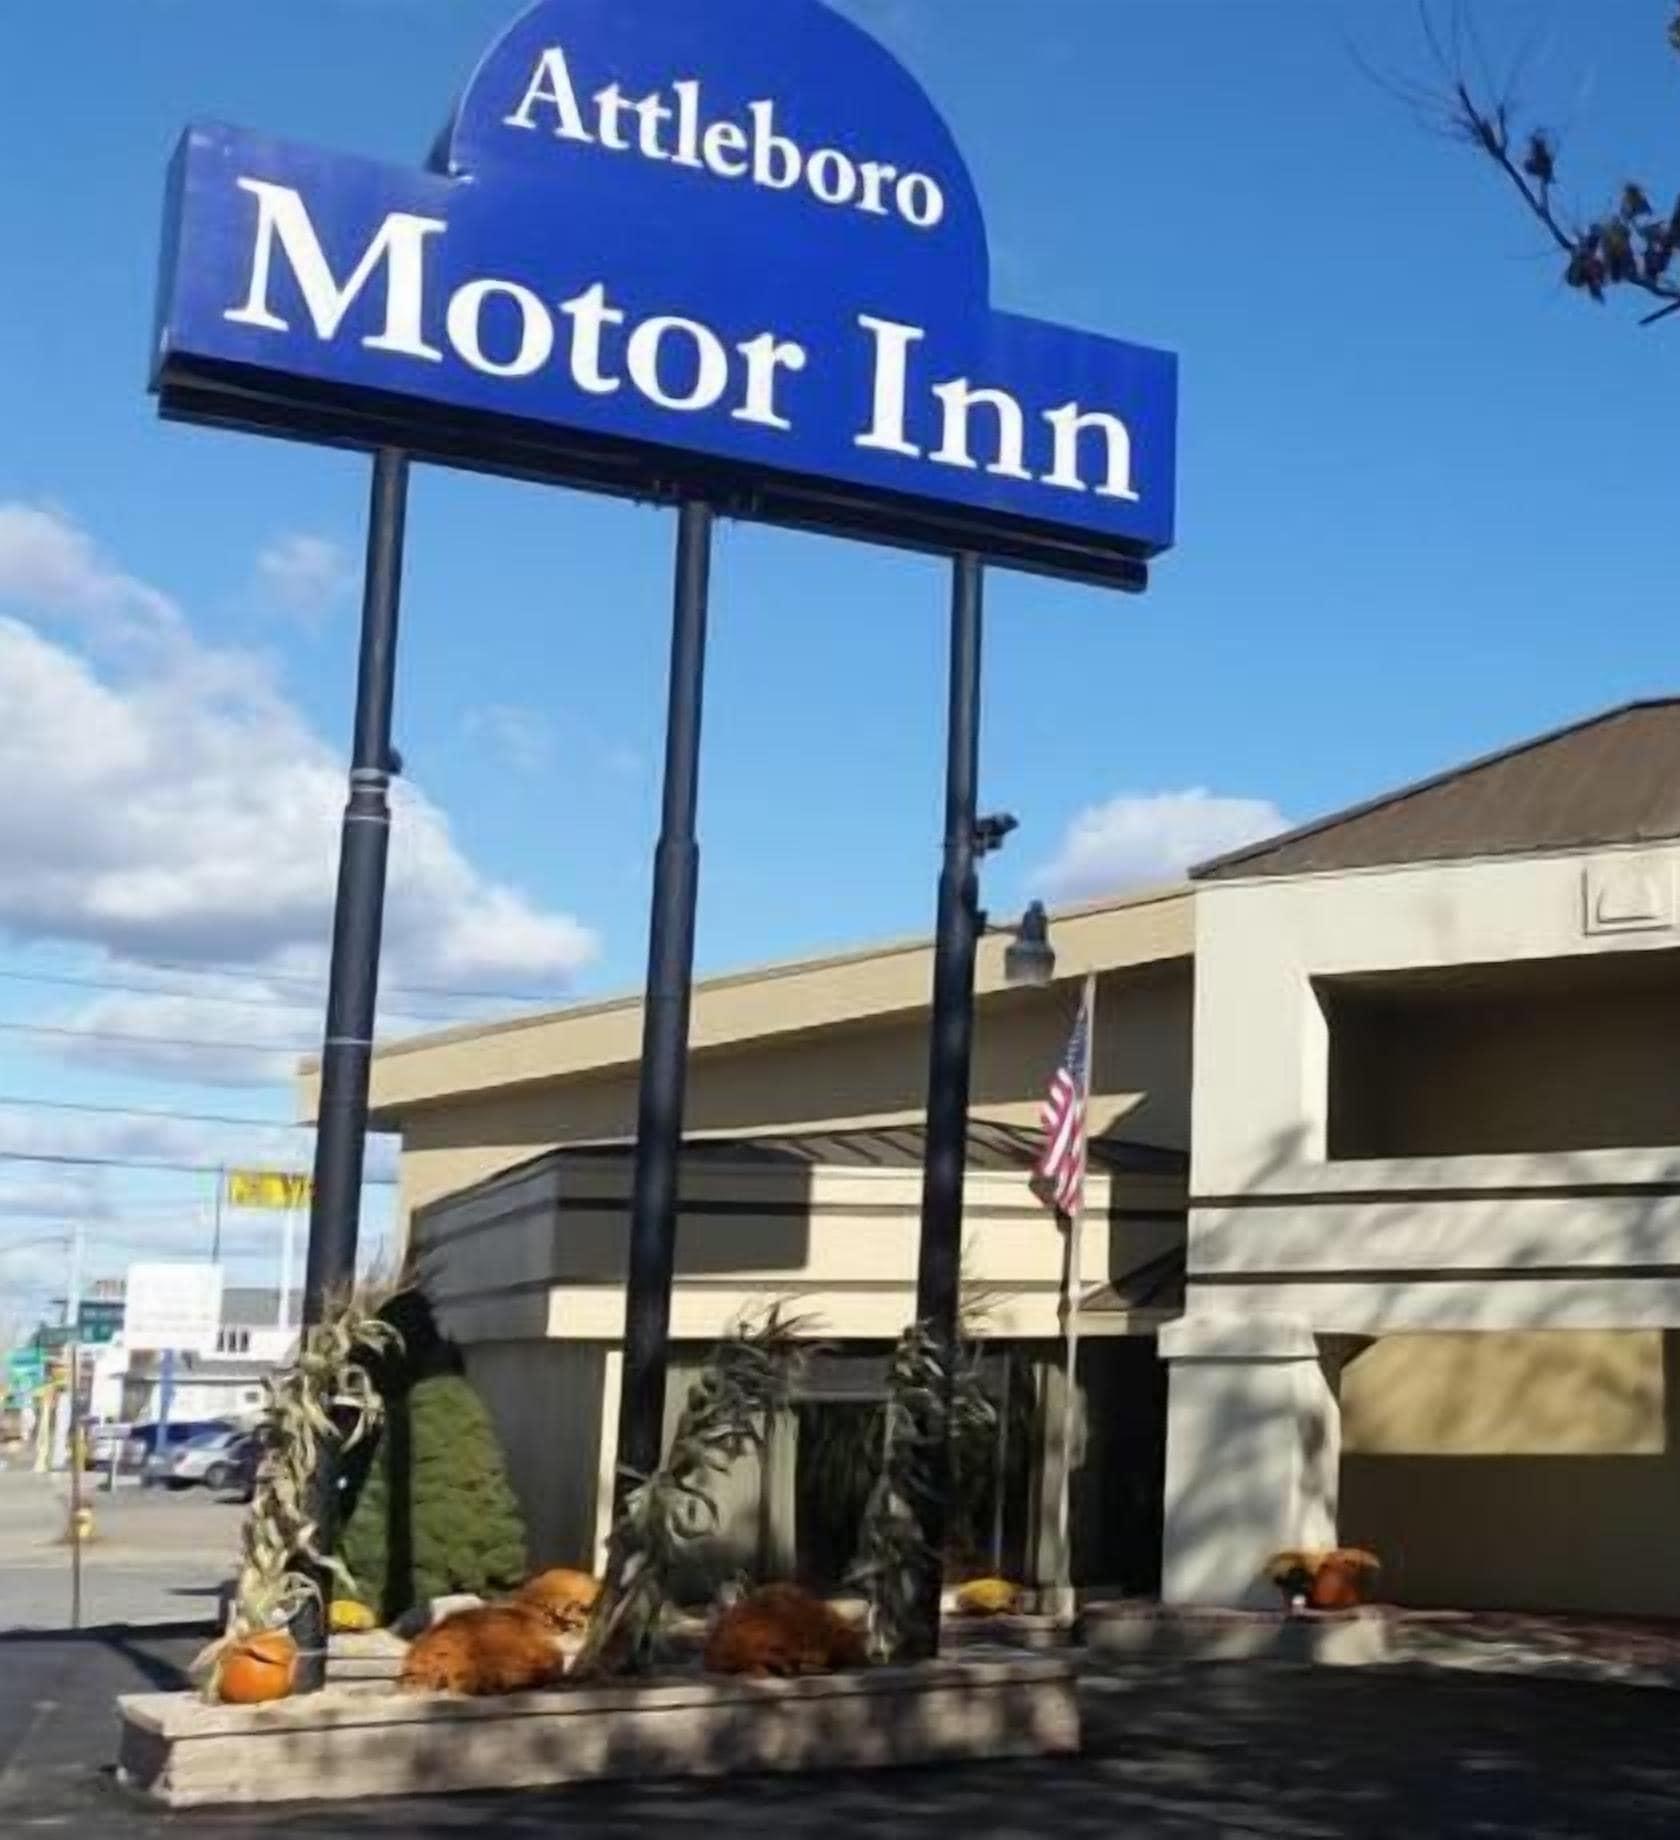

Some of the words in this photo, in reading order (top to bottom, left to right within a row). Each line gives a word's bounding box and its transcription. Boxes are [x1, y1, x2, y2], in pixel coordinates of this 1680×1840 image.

[503, 46, 944, 229] Attleboro
[222, 175, 808, 432] Motor
[853, 313, 1140, 502] Inn
